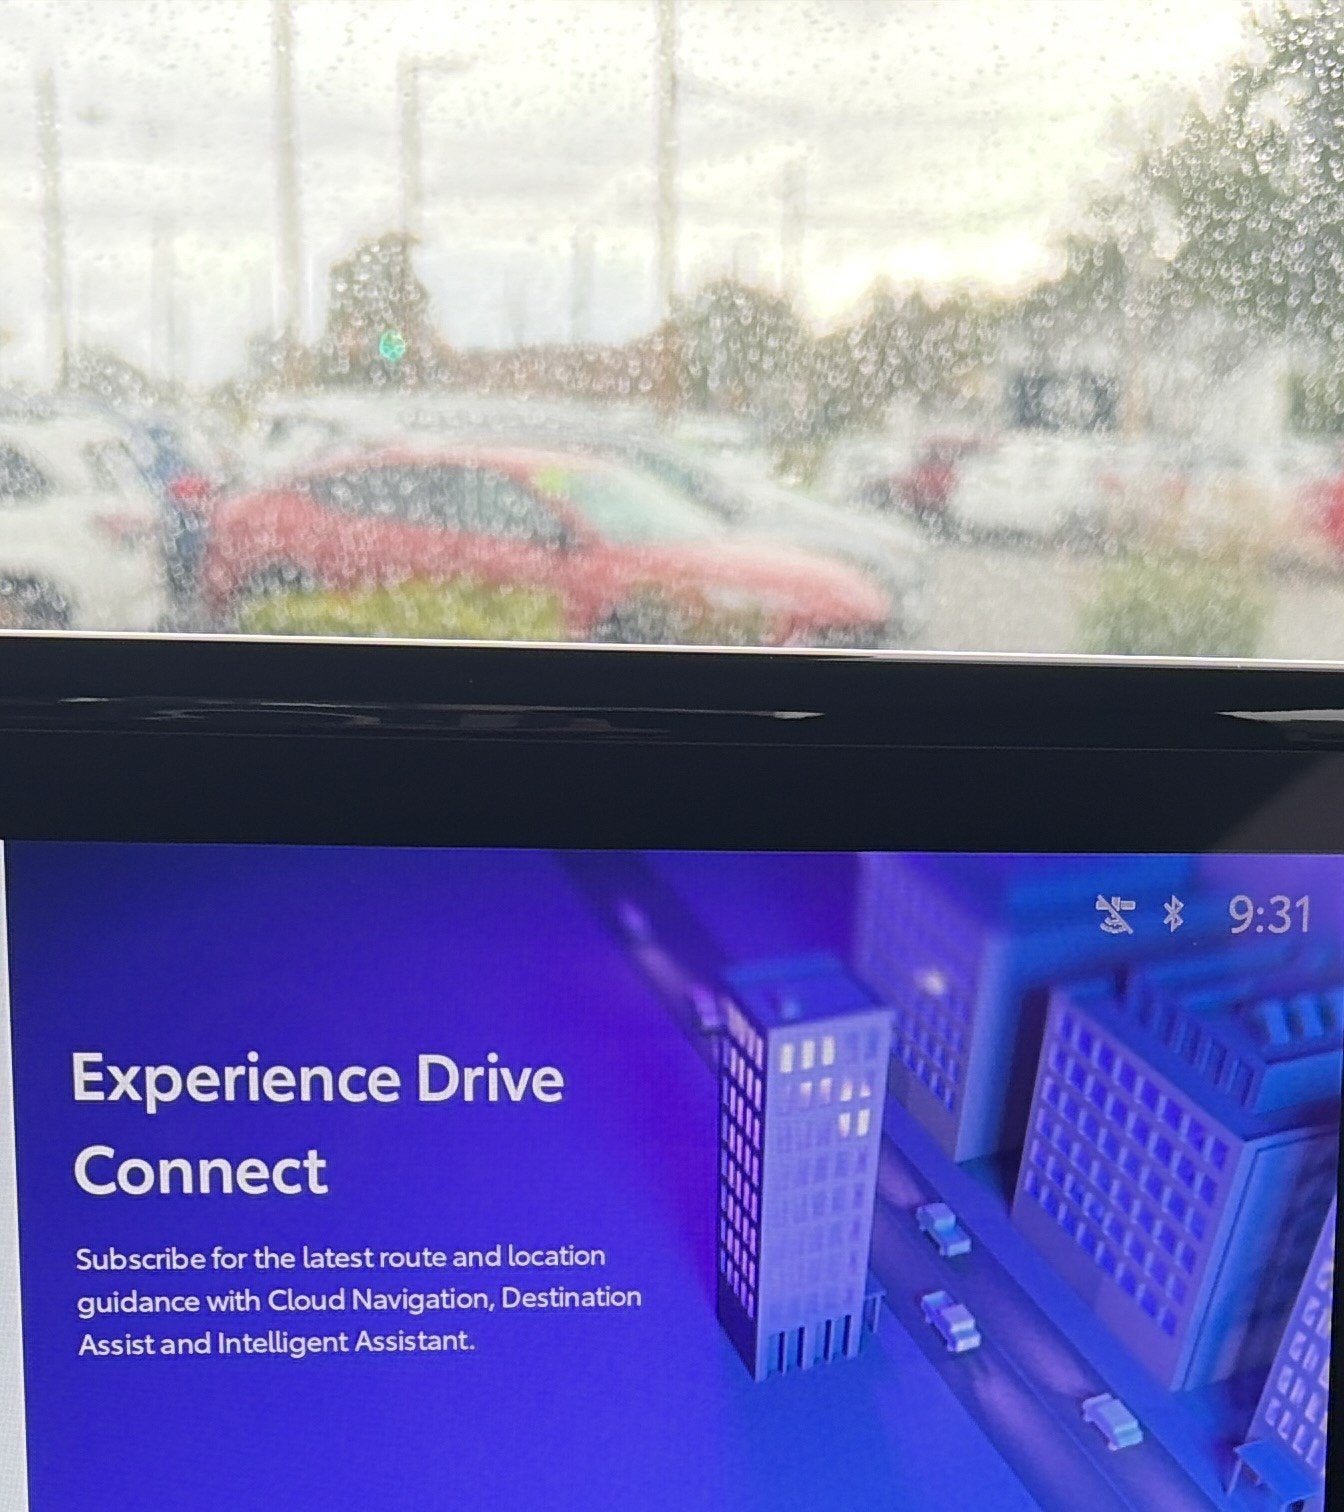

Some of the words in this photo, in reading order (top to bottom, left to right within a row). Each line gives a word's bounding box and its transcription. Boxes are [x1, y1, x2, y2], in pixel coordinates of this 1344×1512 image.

[1229, 894, 1311, 934] 9:31
[72, 1050, 402, 1115] Experience
[418, 1052, 565, 1103] Drive
[74, 1145, 329, 1195] Connect
[76, 1246, 207, 1271] Subscribe
[210, 1246, 249, 1270] for
[253, 1245, 296, 1269] the
[303, 1245, 375, 1269] latest
[379, 1247, 448, 1268] route
[452, 1243, 502, 1268] and
[508, 1243, 606, 1267] location
[77, 1289, 201, 1320] guidance
[206, 1288, 261, 1312] with
[268, 1287, 346, 1312] Cloud
[352, 1287, 496, 1316] Navigation,
[502, 1285, 642, 1309] Destination
[78, 1333, 157, 1357] Assist
[160, 1331, 212, 1355] and
[218, 1330, 350, 1359] Intelligent
[354, 1329, 475, 1352] Assistant.
